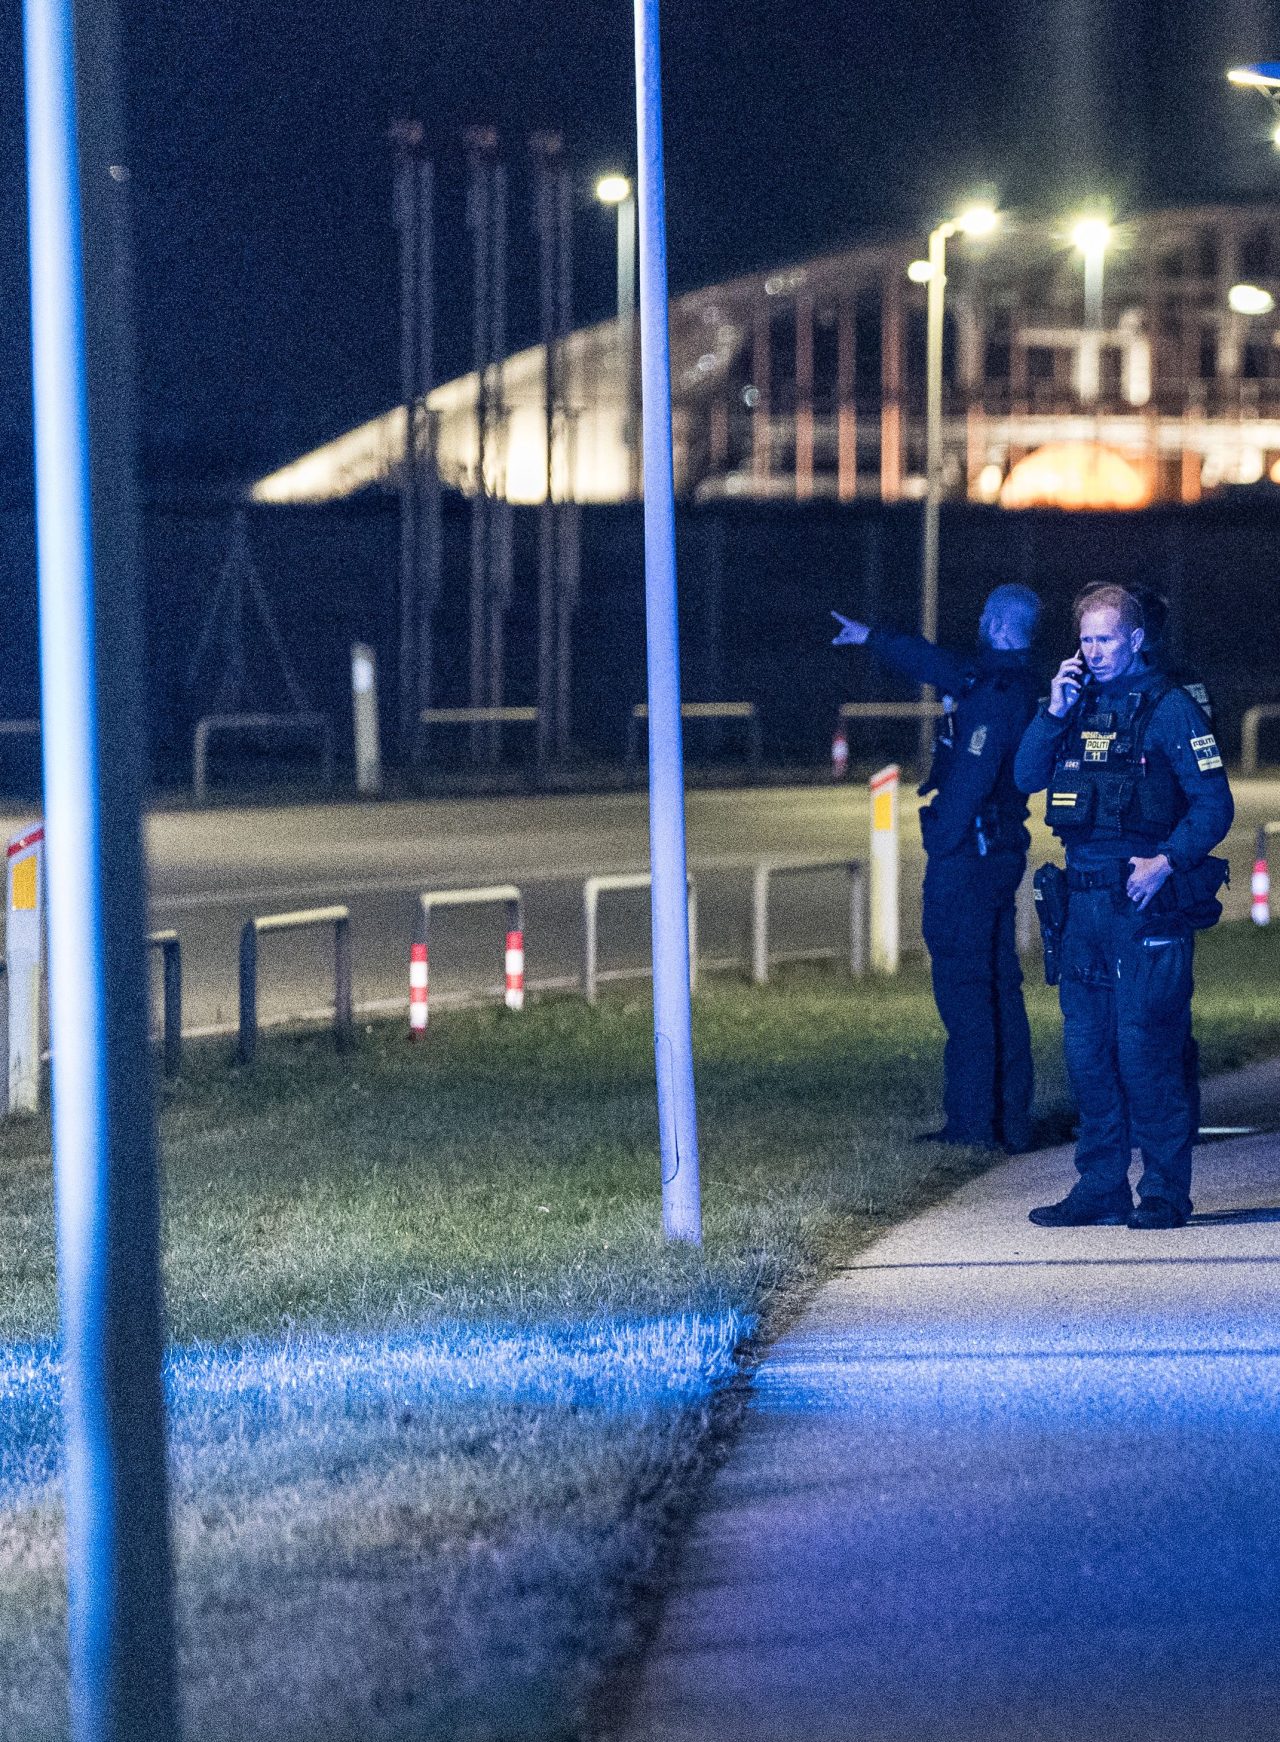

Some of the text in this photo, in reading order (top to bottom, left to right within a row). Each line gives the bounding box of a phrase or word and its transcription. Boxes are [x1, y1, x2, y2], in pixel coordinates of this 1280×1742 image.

[1087, 741, 1108, 749] POLITI
[1193, 737, 1214, 747] POLITI
[1203, 748, 1213, 757] 11
